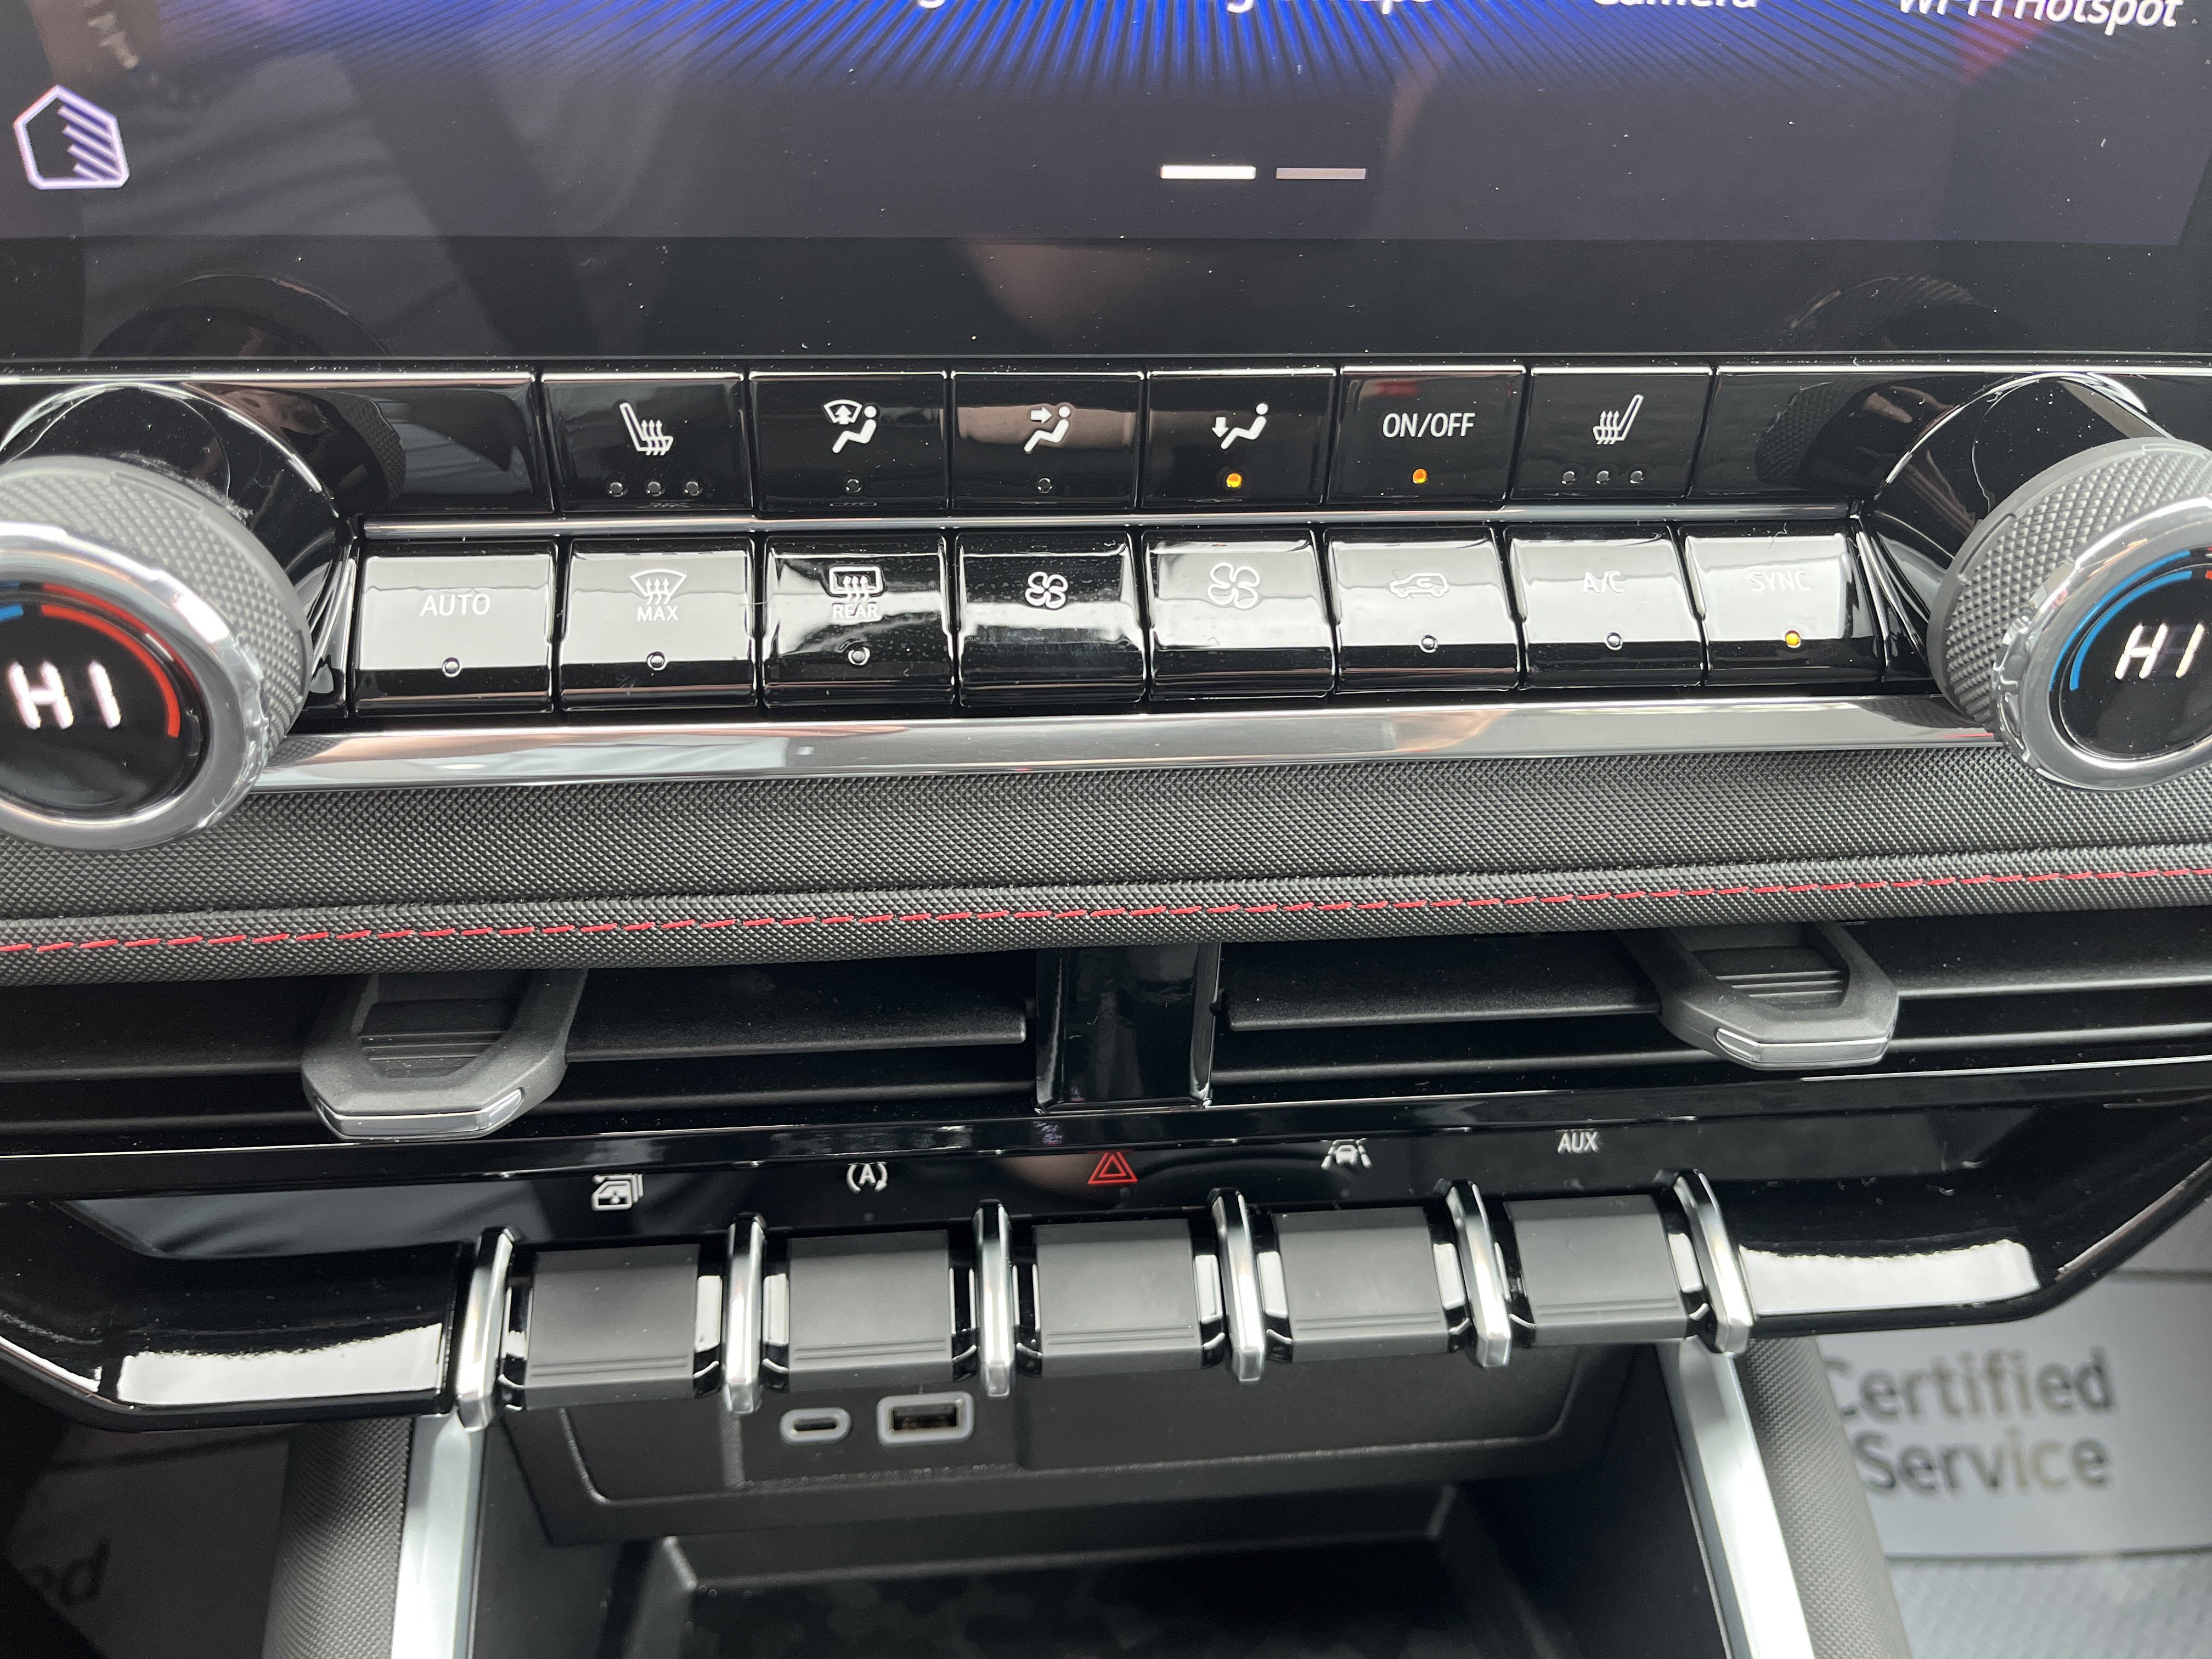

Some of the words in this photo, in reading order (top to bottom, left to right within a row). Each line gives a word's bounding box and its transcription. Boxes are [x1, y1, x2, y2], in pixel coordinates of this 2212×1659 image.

[1383, 413, 1475, 437] ON/OFF
[1583, 570, 1624, 593] A/C
[1749, 571, 1810, 591] SYNC
[420, 593, 491, 616] AUTO
[637, 605, 679, 622] MAX
[832, 603, 878, 619] REAR
[2115, 622, 2205, 680] HI
[8, 661, 121, 729] HI
[1557, 1131, 1600, 1154] AUX
[1850, 1426, 2111, 1496] Service
